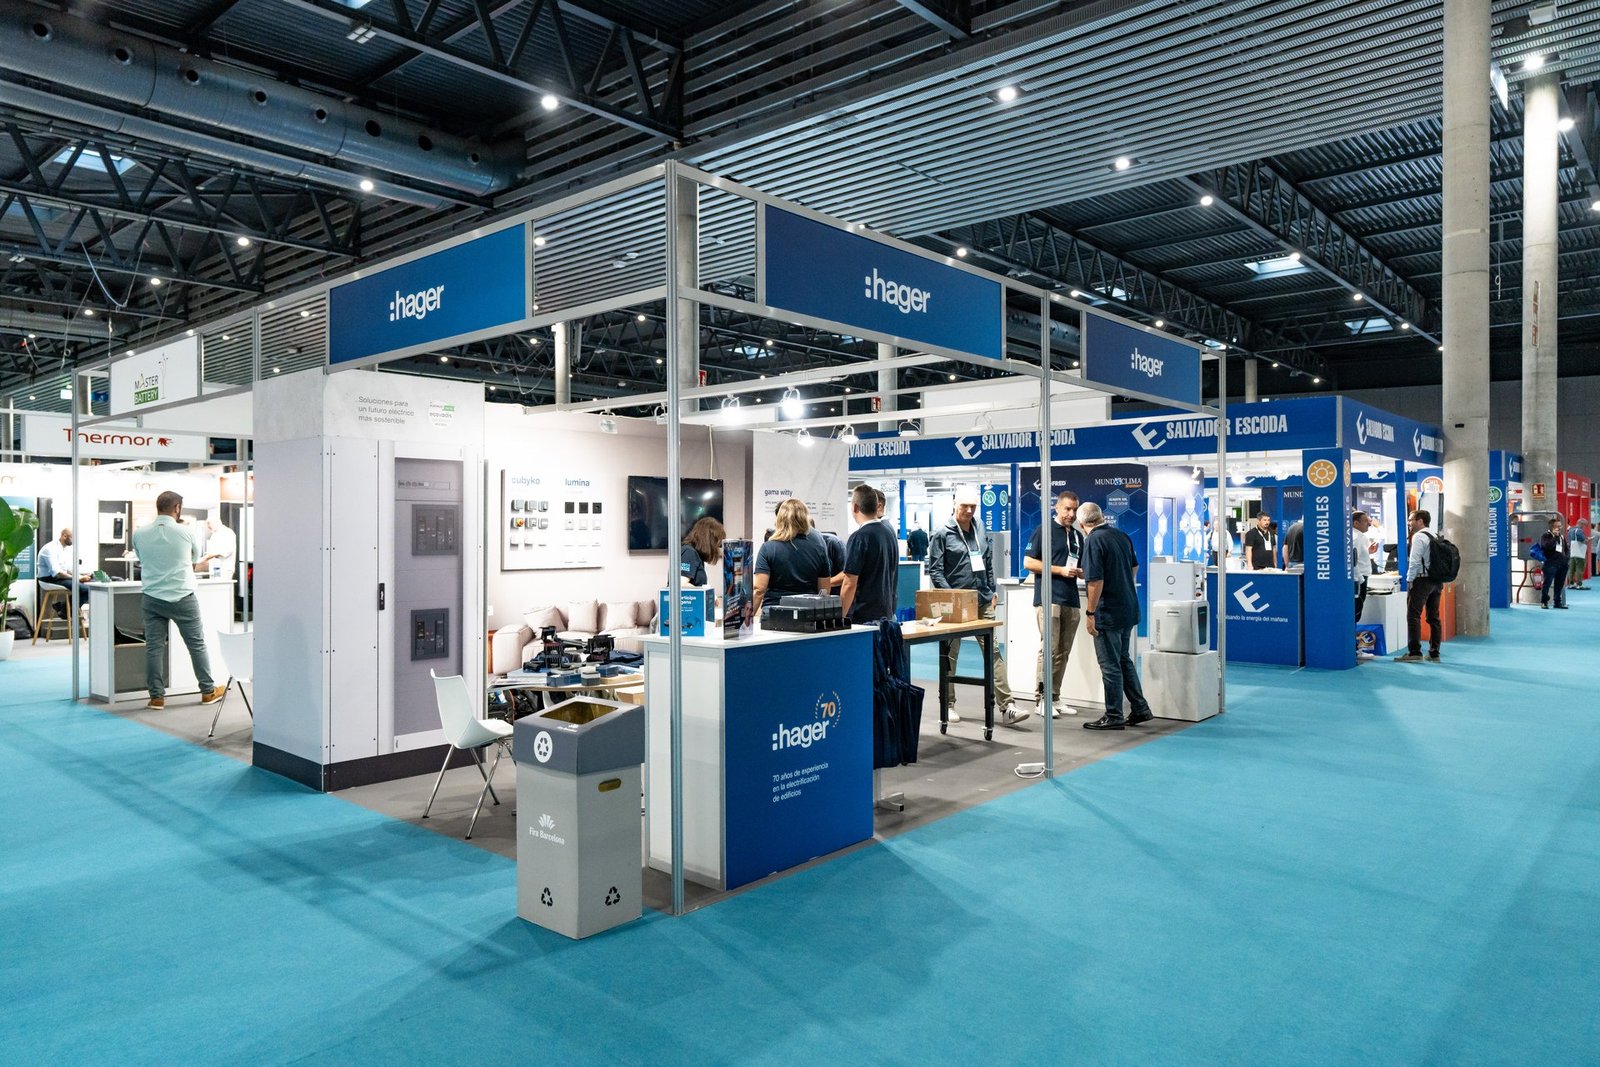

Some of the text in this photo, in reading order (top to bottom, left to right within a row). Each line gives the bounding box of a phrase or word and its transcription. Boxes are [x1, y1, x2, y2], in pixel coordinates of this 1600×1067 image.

[358, 395, 394, 406] Soluciones
[368, 406, 387, 414] futuro
[373, 416, 406, 425] sostenible
[1235, 414, 1288, 435] ESCODA
[981, 431, 1032, 451] SALVADOR
[1035, 429, 1076, 447] ECODA
[878, 440, 911, 456] ESCODA
[511, 475, 590, 487] cubyko lumina
[764, 489, 793, 498] gama witty
[1316, 495, 1330, 580] RENOVABLES
[820, 701, 836, 719] 70
[772, 775, 780, 783] 70
[780, 771, 793, 781] años
[801, 762, 829, 775] experiencia
[786, 774, 820, 789] electrificación
[772, 789, 802, 803] de edificios
[529, 826, 565, 845] Fira Barcelona
